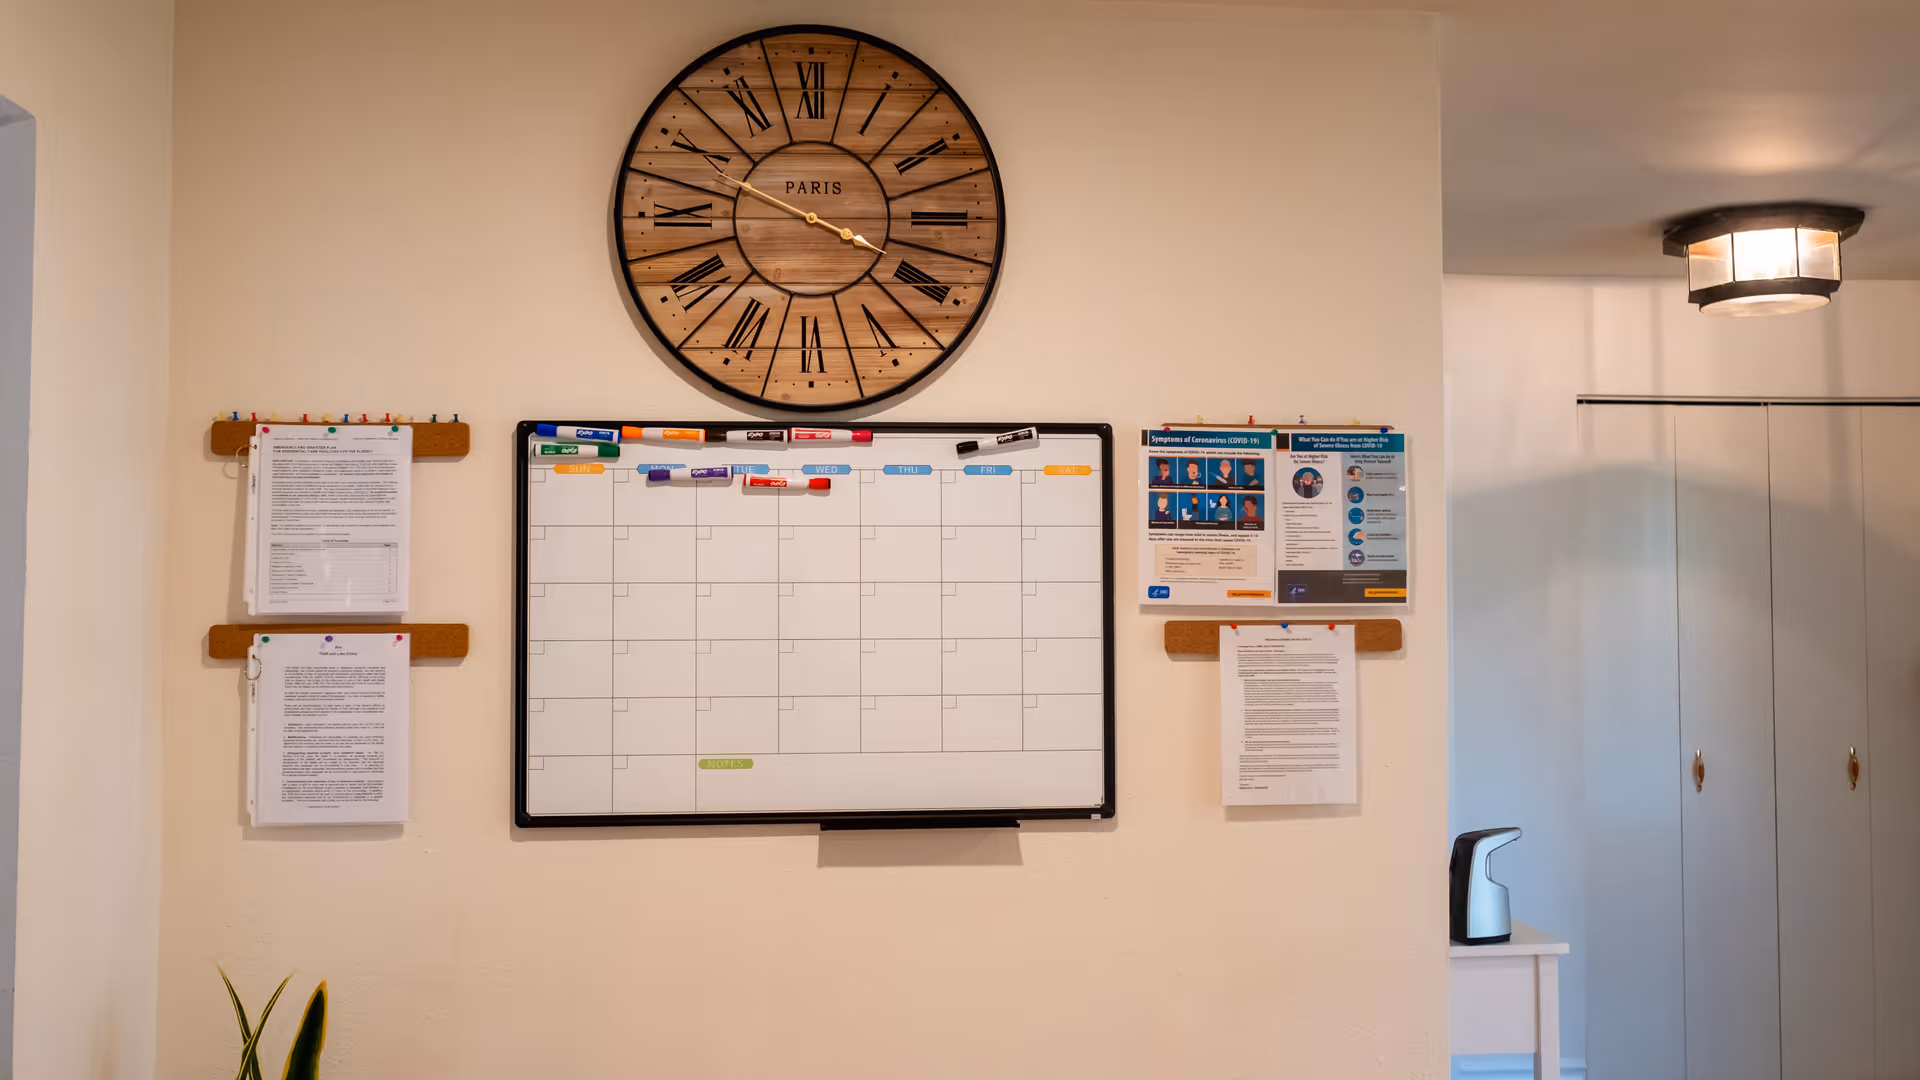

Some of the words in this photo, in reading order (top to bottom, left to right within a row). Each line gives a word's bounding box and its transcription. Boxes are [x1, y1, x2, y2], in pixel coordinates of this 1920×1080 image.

[794, 61, 827, 119] XII
[723, 76, 773, 138] XI
[785, 181, 843, 195] PARIS
[799, 315, 828, 373] VI
[1151, 435, 1183, 443] Symptoms
[1228, 437, 1260, 445] (COVID-19)
[568, 465, 590, 473] SUN
[735, 465, 753, 473] TUE
[815, 465, 838, 473] WED
[898, 466, 918, 474] THU
[980, 466, 995, 474] FRI
[707, 759, 744, 768] NOTES
